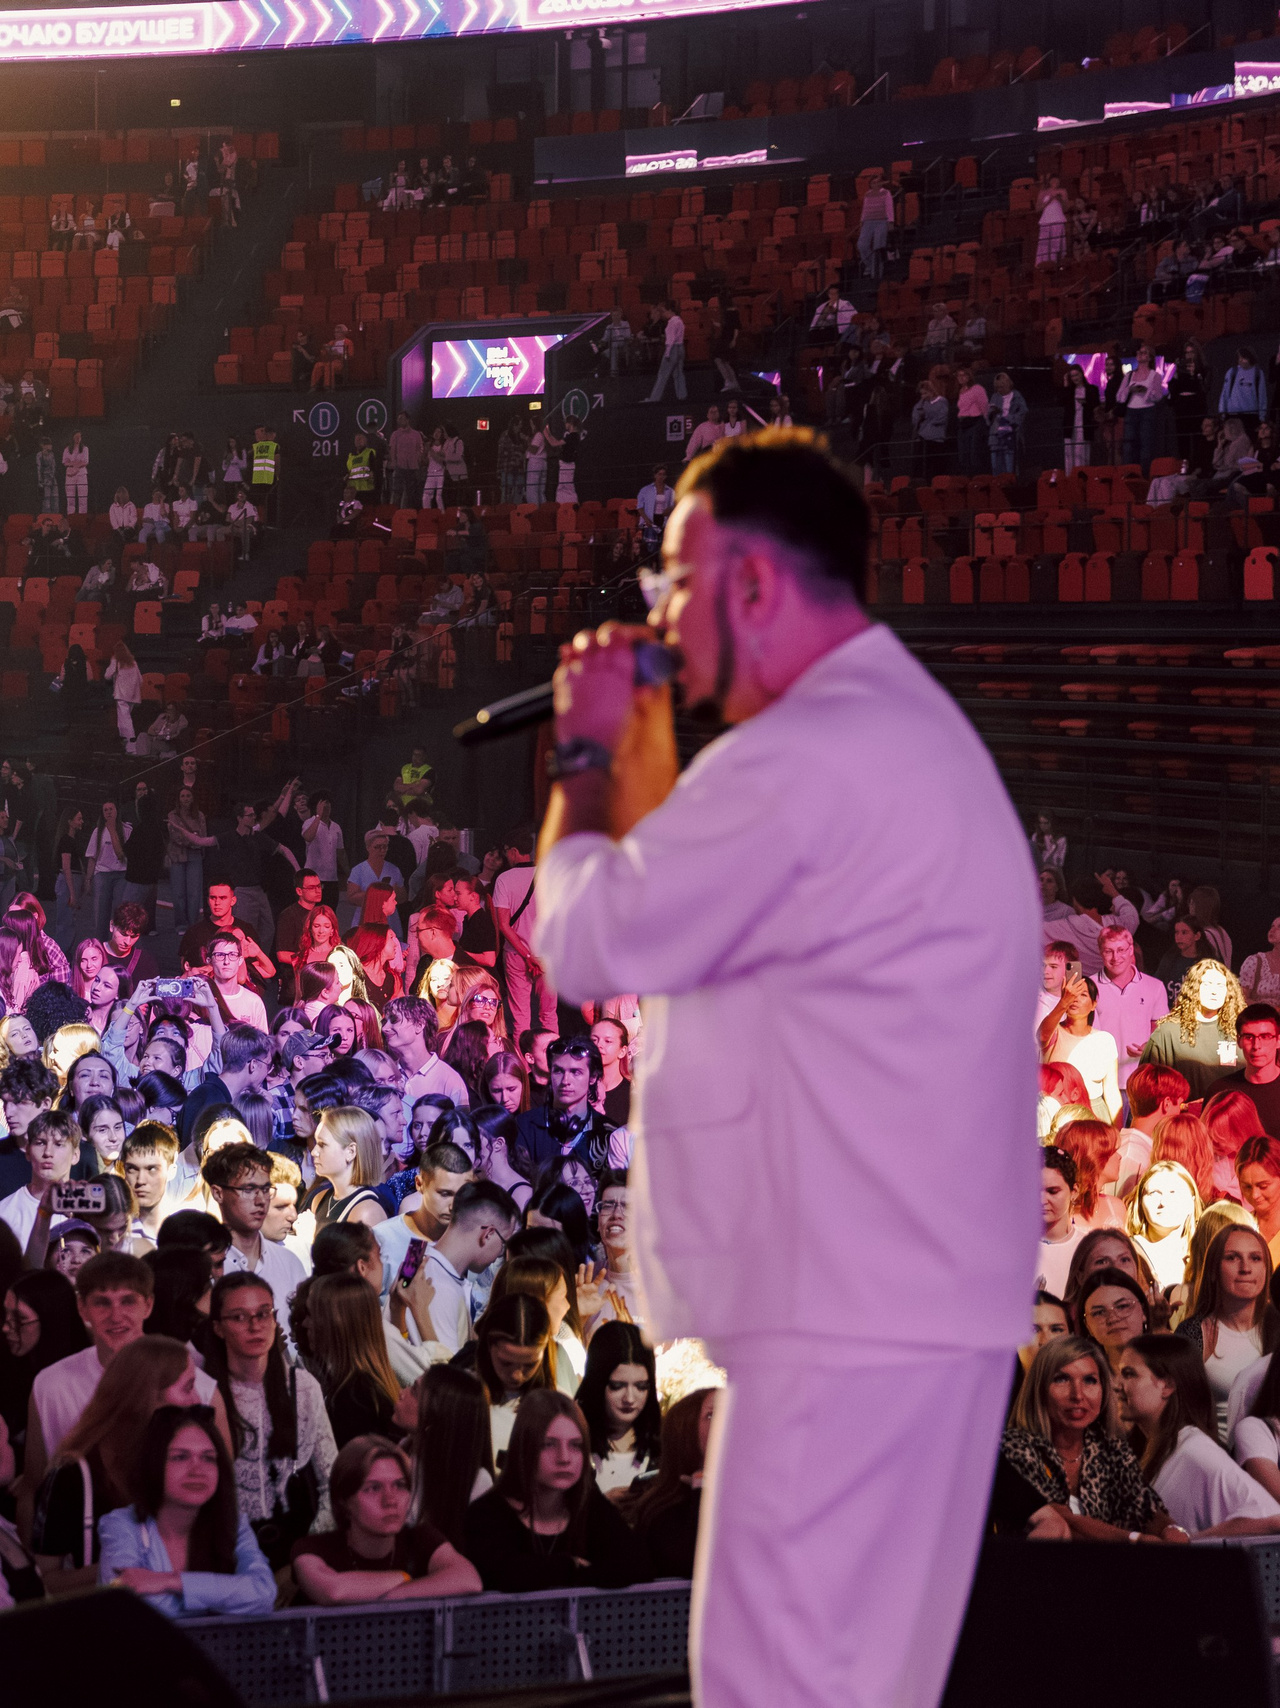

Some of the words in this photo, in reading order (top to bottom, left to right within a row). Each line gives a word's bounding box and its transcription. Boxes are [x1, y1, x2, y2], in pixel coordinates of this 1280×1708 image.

[76, 17, 194, 46] БУДУЩЕЕ
[319, 408, 331, 431] D
[312, 440, 340, 457] 201
